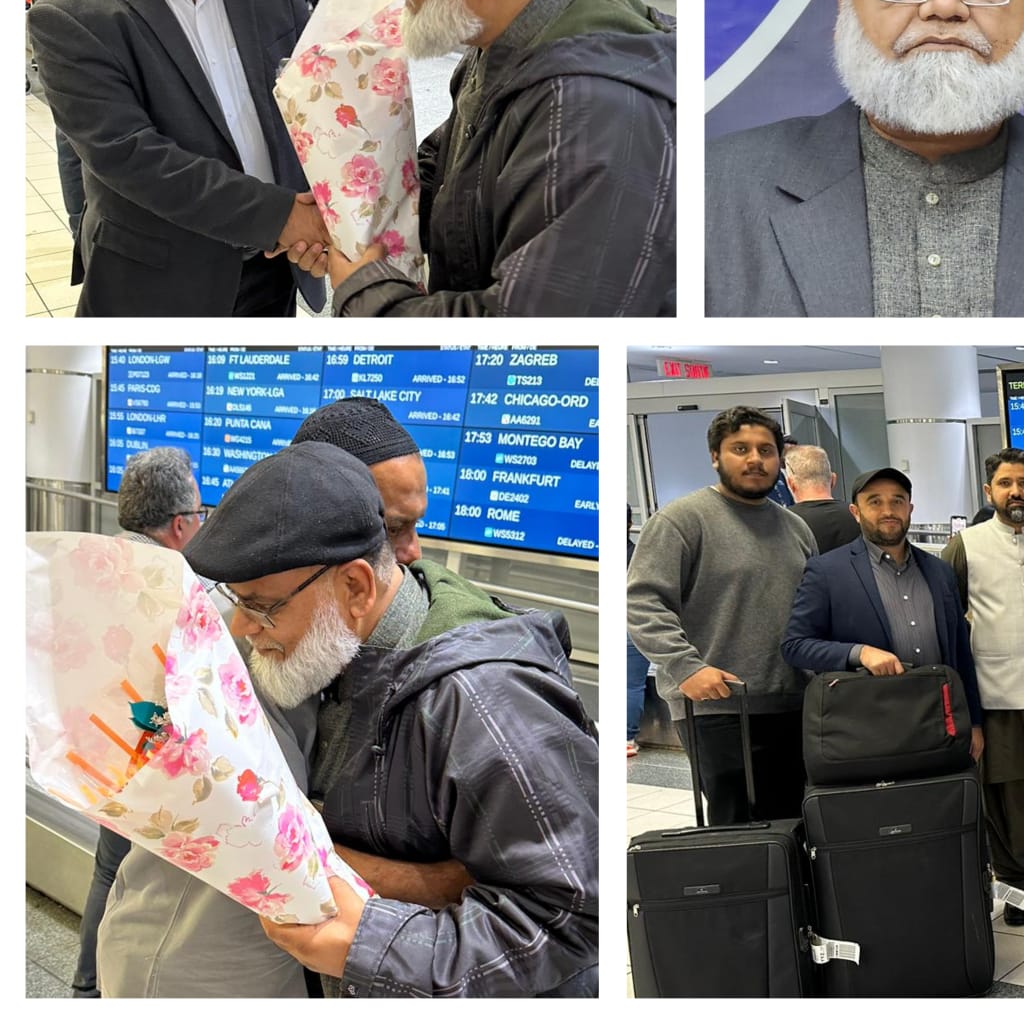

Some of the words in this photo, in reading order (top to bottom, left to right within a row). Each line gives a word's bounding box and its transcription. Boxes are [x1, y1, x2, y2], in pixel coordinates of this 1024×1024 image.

[326, 354, 349, 365] 16:59
[353, 354, 394, 365] DETROIT
[475, 353, 504, 366] 17:20
[509, 354, 558, 366] ZAGREB
[412, 374, 443, 383] ARRIVED
[516, 375, 542, 386] TS213
[398, 391, 421, 402] CITY
[470, 392, 498, 405] 17:42
[504, 393, 589, 408] CHICAGO-ORD
[408, 411, 438, 421] ARRIVED
[510, 414, 541, 426] AA6291
[464, 431, 492, 444] 17:53
[497, 433, 557, 448] MONTEGO
[558, 435, 583, 450] BAY
[504, 454, 537, 466] WS2703
[459, 468, 487, 482] 18:00
[492, 470, 561, 488] FRANKFURT
[498, 491, 530, 504] DE2402
[454, 504, 482, 518] 18:00
[487, 508, 521, 523] ROME
[492, 528, 526, 542] WS5312
[557, 536, 594, 550] DELAYED
